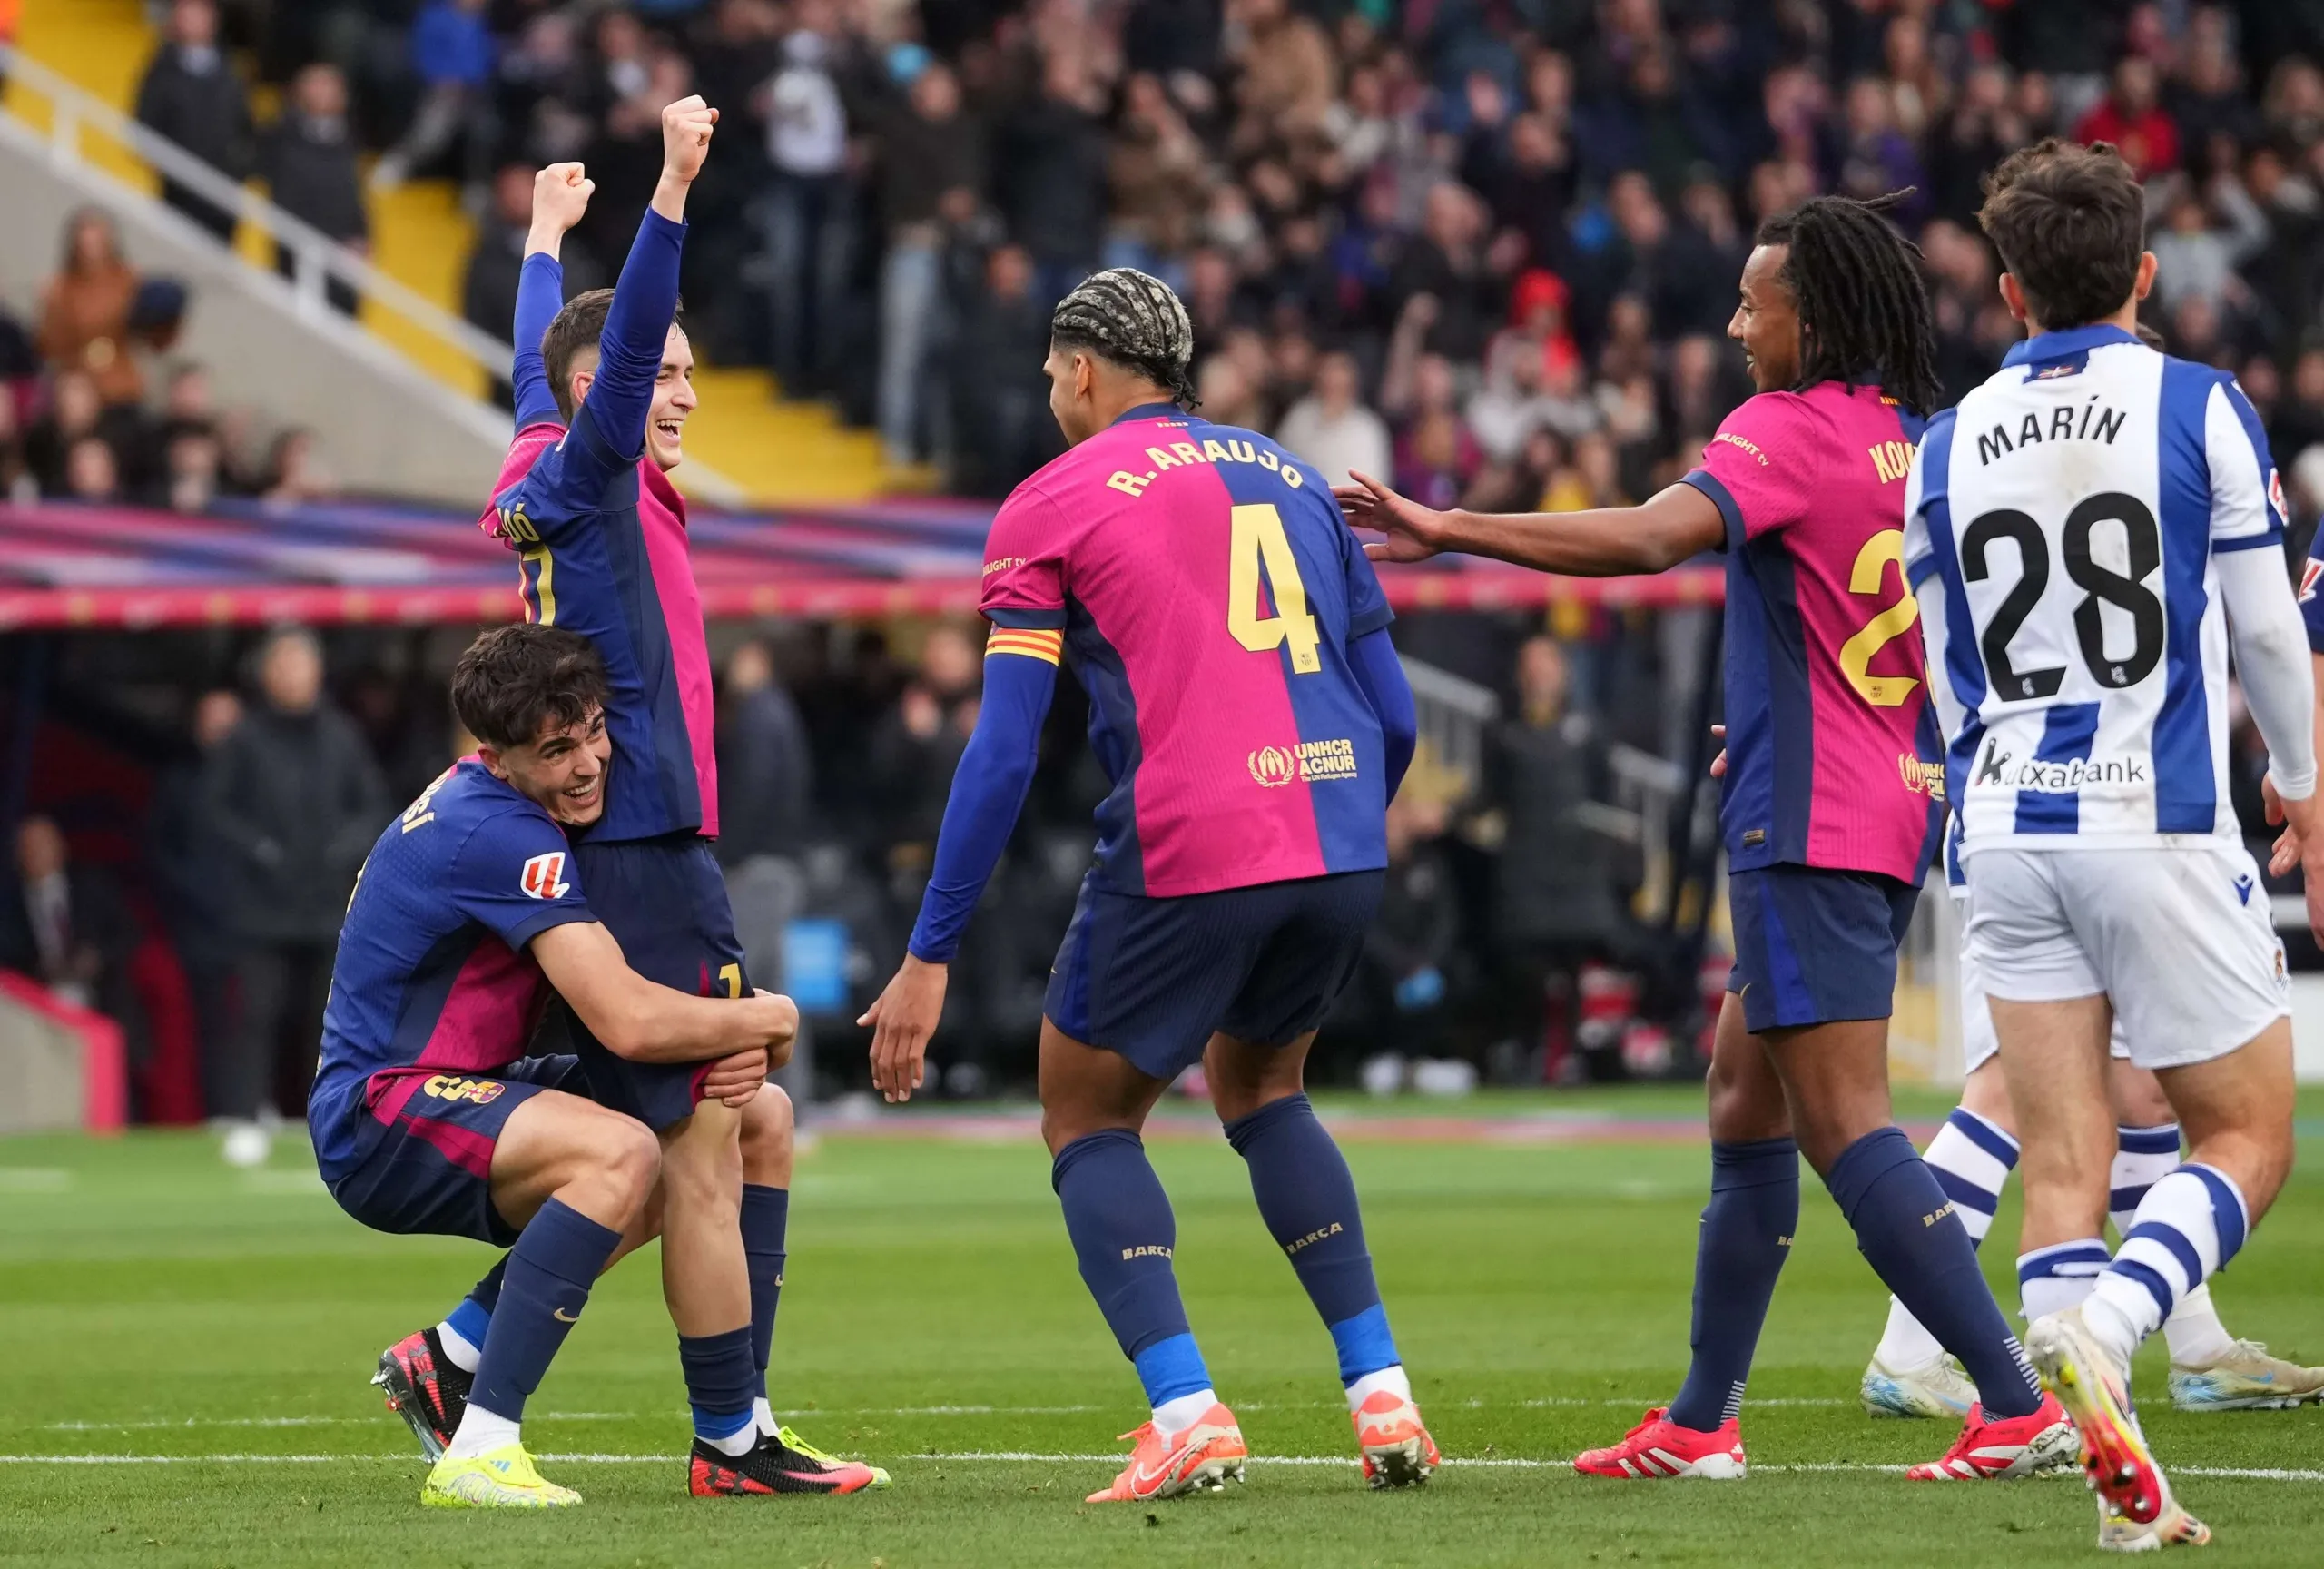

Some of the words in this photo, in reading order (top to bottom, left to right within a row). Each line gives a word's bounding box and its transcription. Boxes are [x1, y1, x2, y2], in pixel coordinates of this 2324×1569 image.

[1868, 440, 1917, 484] KOU
[1977, 394, 2126, 466] MARÍN
[1106, 470, 1157, 497] R.
[1145, 439, 1303, 488] ARAUJO
[1227, 504, 1321, 674] 4
[1839, 528, 1935, 706] 2
[1961, 491, 2164, 702] 28
[1294, 739, 1353, 759] UNHCR
[1299, 755, 1356, 775] ACNUR
